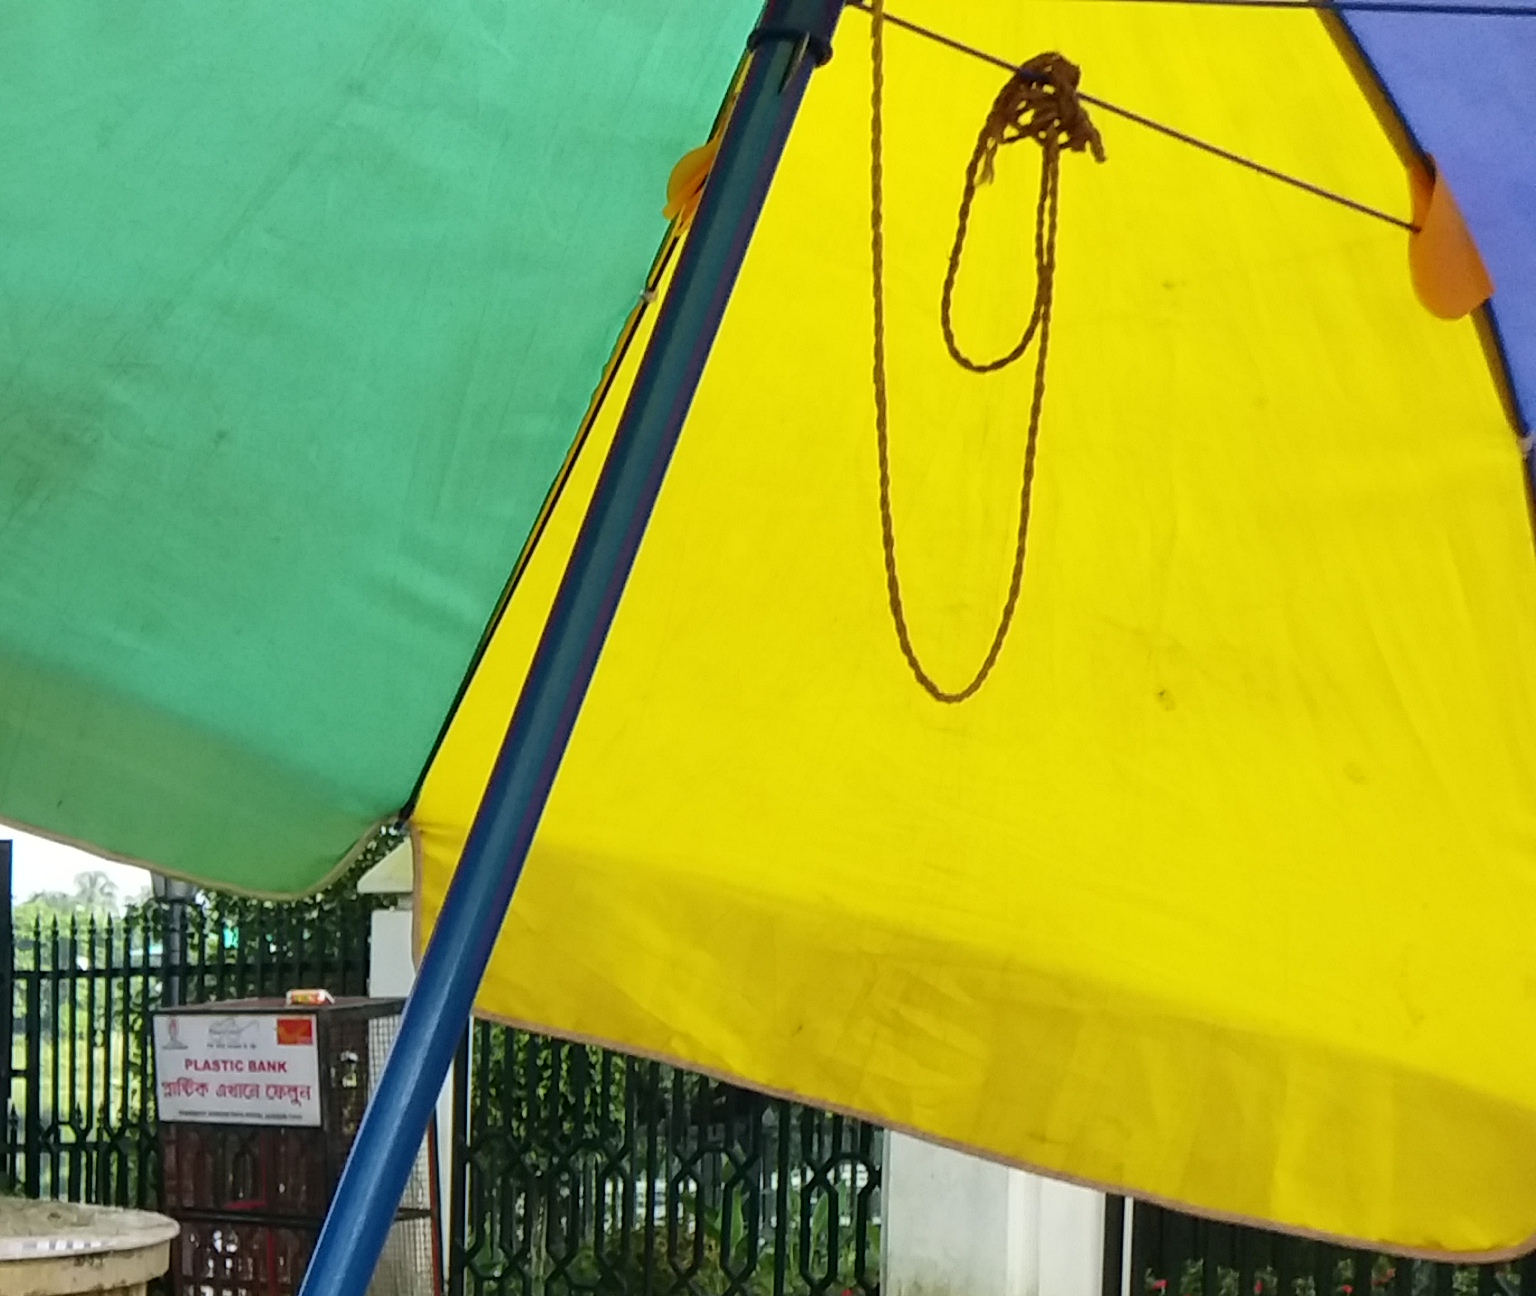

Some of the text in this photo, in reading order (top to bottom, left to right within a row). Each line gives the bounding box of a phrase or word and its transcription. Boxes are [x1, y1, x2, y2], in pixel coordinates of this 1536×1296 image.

[184, 1058, 287, 1073] PLASTIC BANK
[216, 1082, 260, 1100] এখানে
[265, 1083, 311, 1107] ফেলুন
